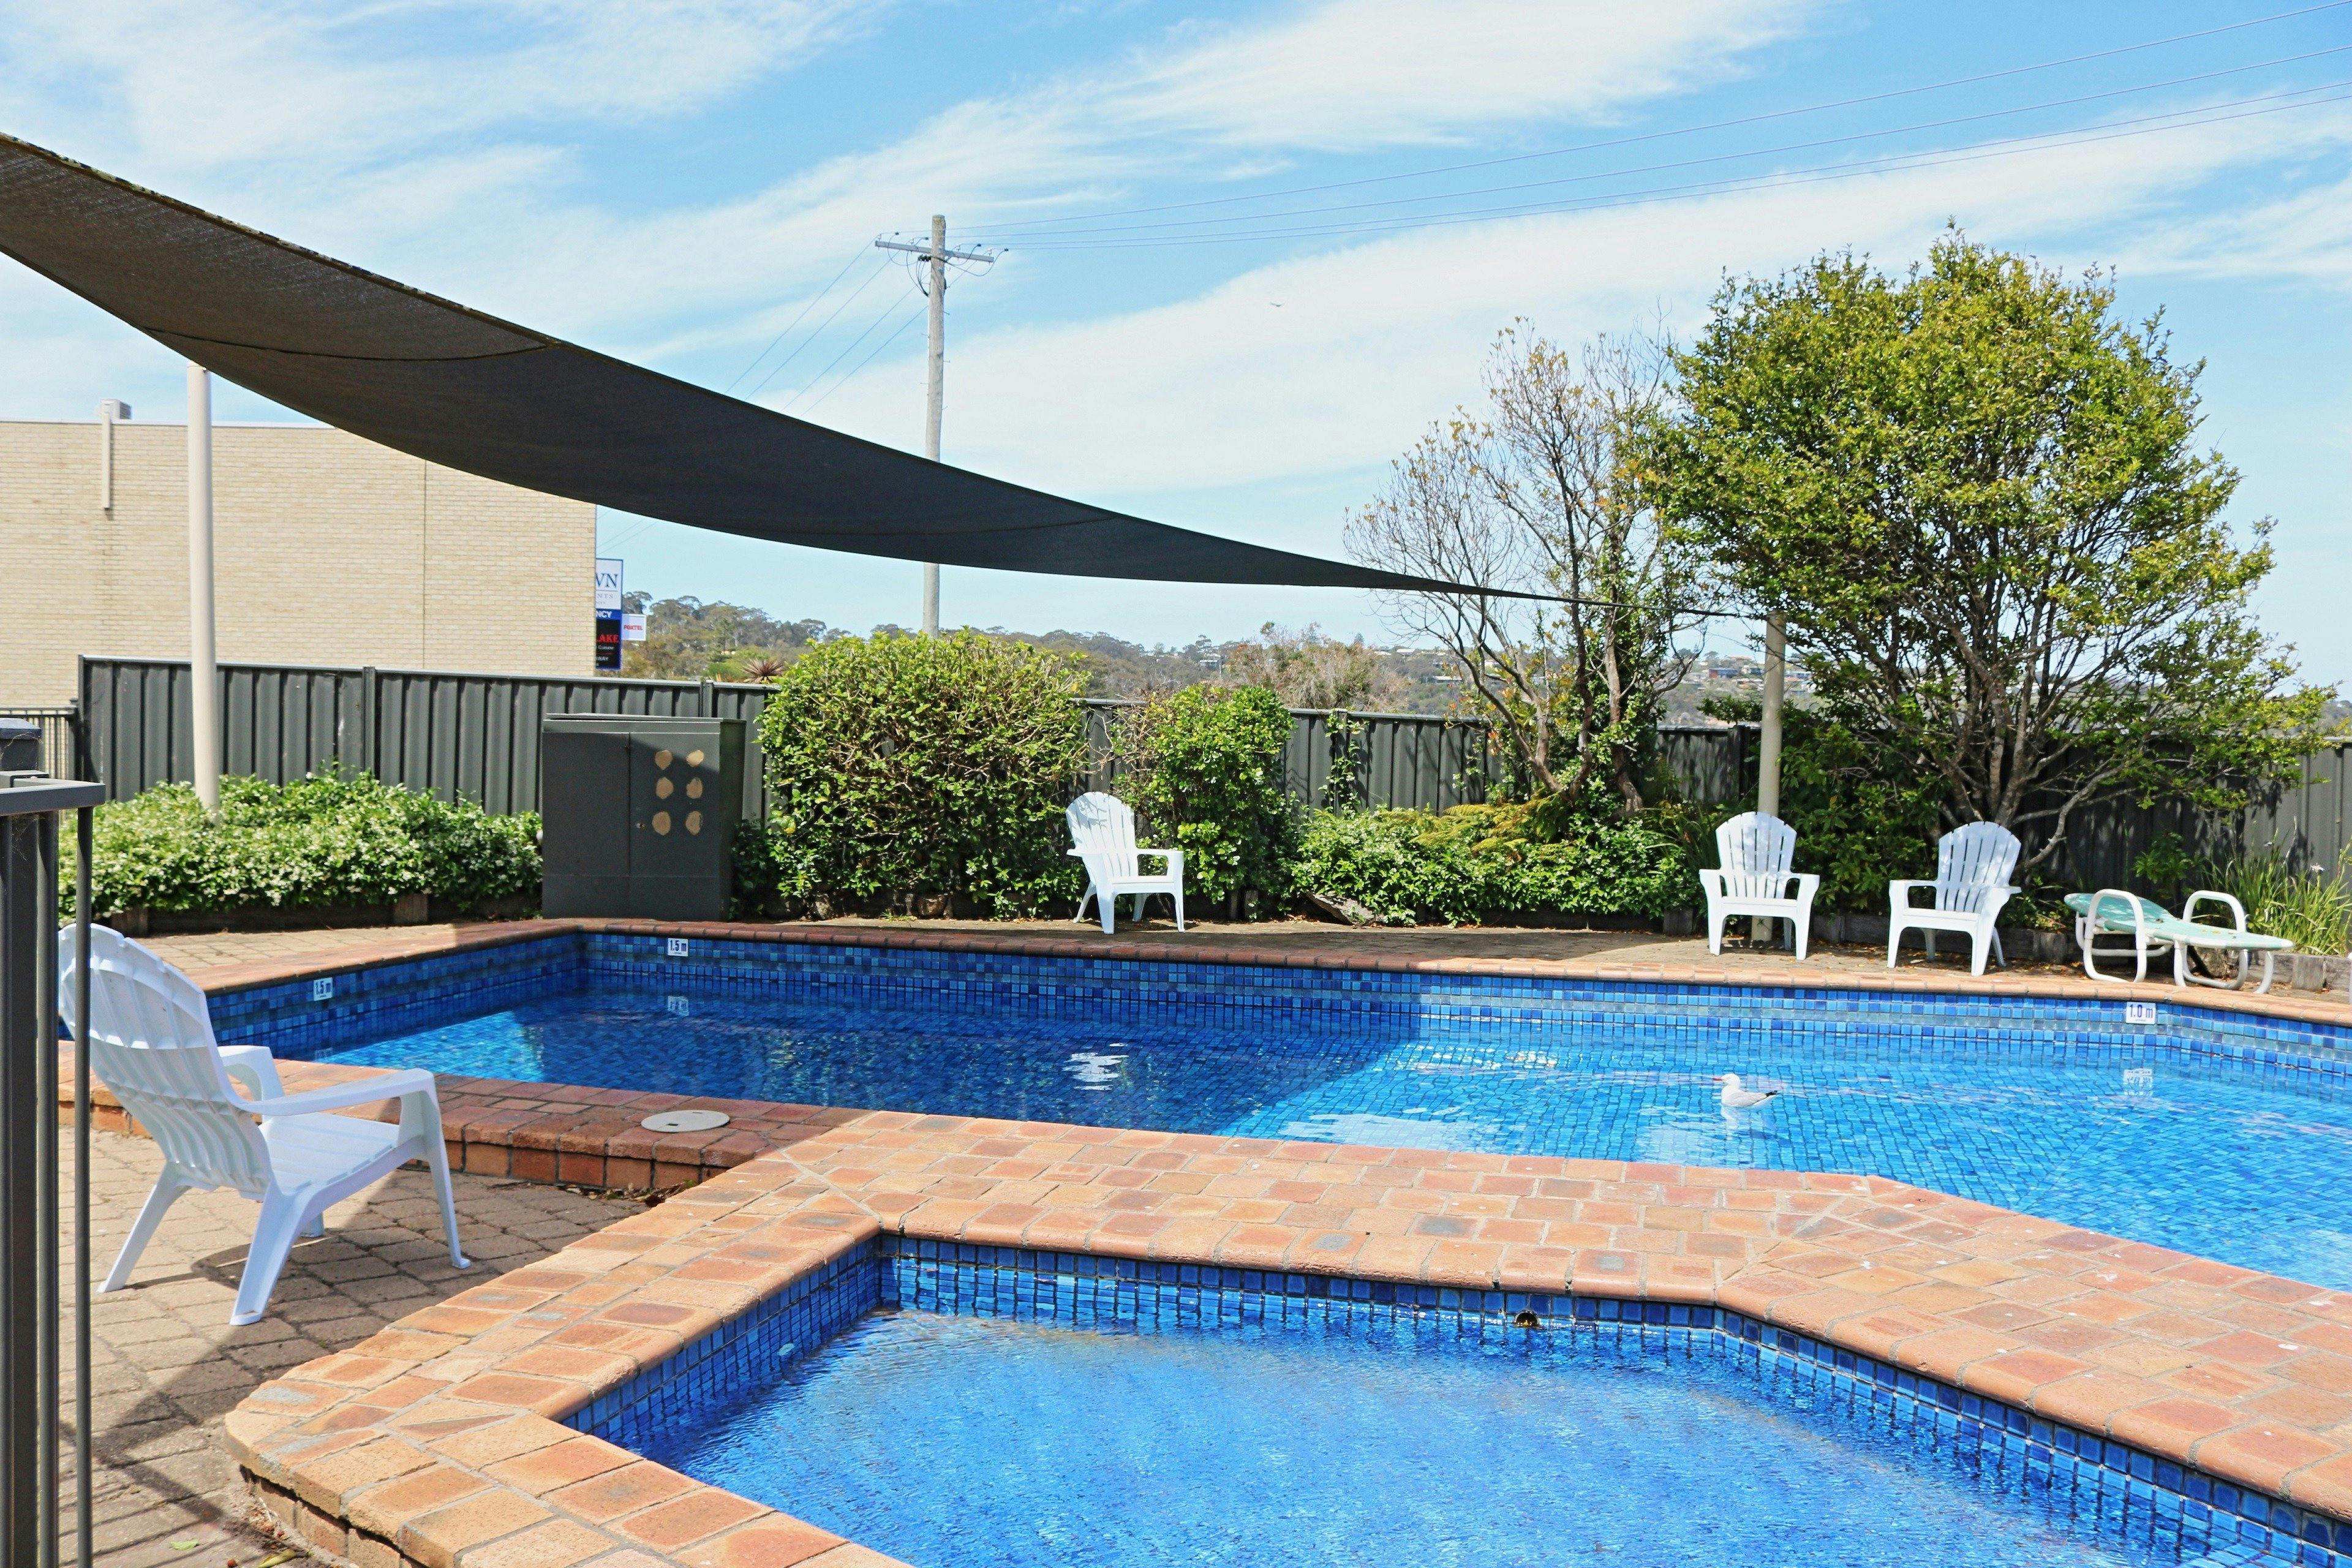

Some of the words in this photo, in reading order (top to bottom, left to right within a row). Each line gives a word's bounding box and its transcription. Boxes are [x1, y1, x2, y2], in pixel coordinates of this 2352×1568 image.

[670, 940, 679, 951] 1.5
[2130, 1004, 2143, 1017] 1.0
[2146, 1008, 2153, 1018] m
